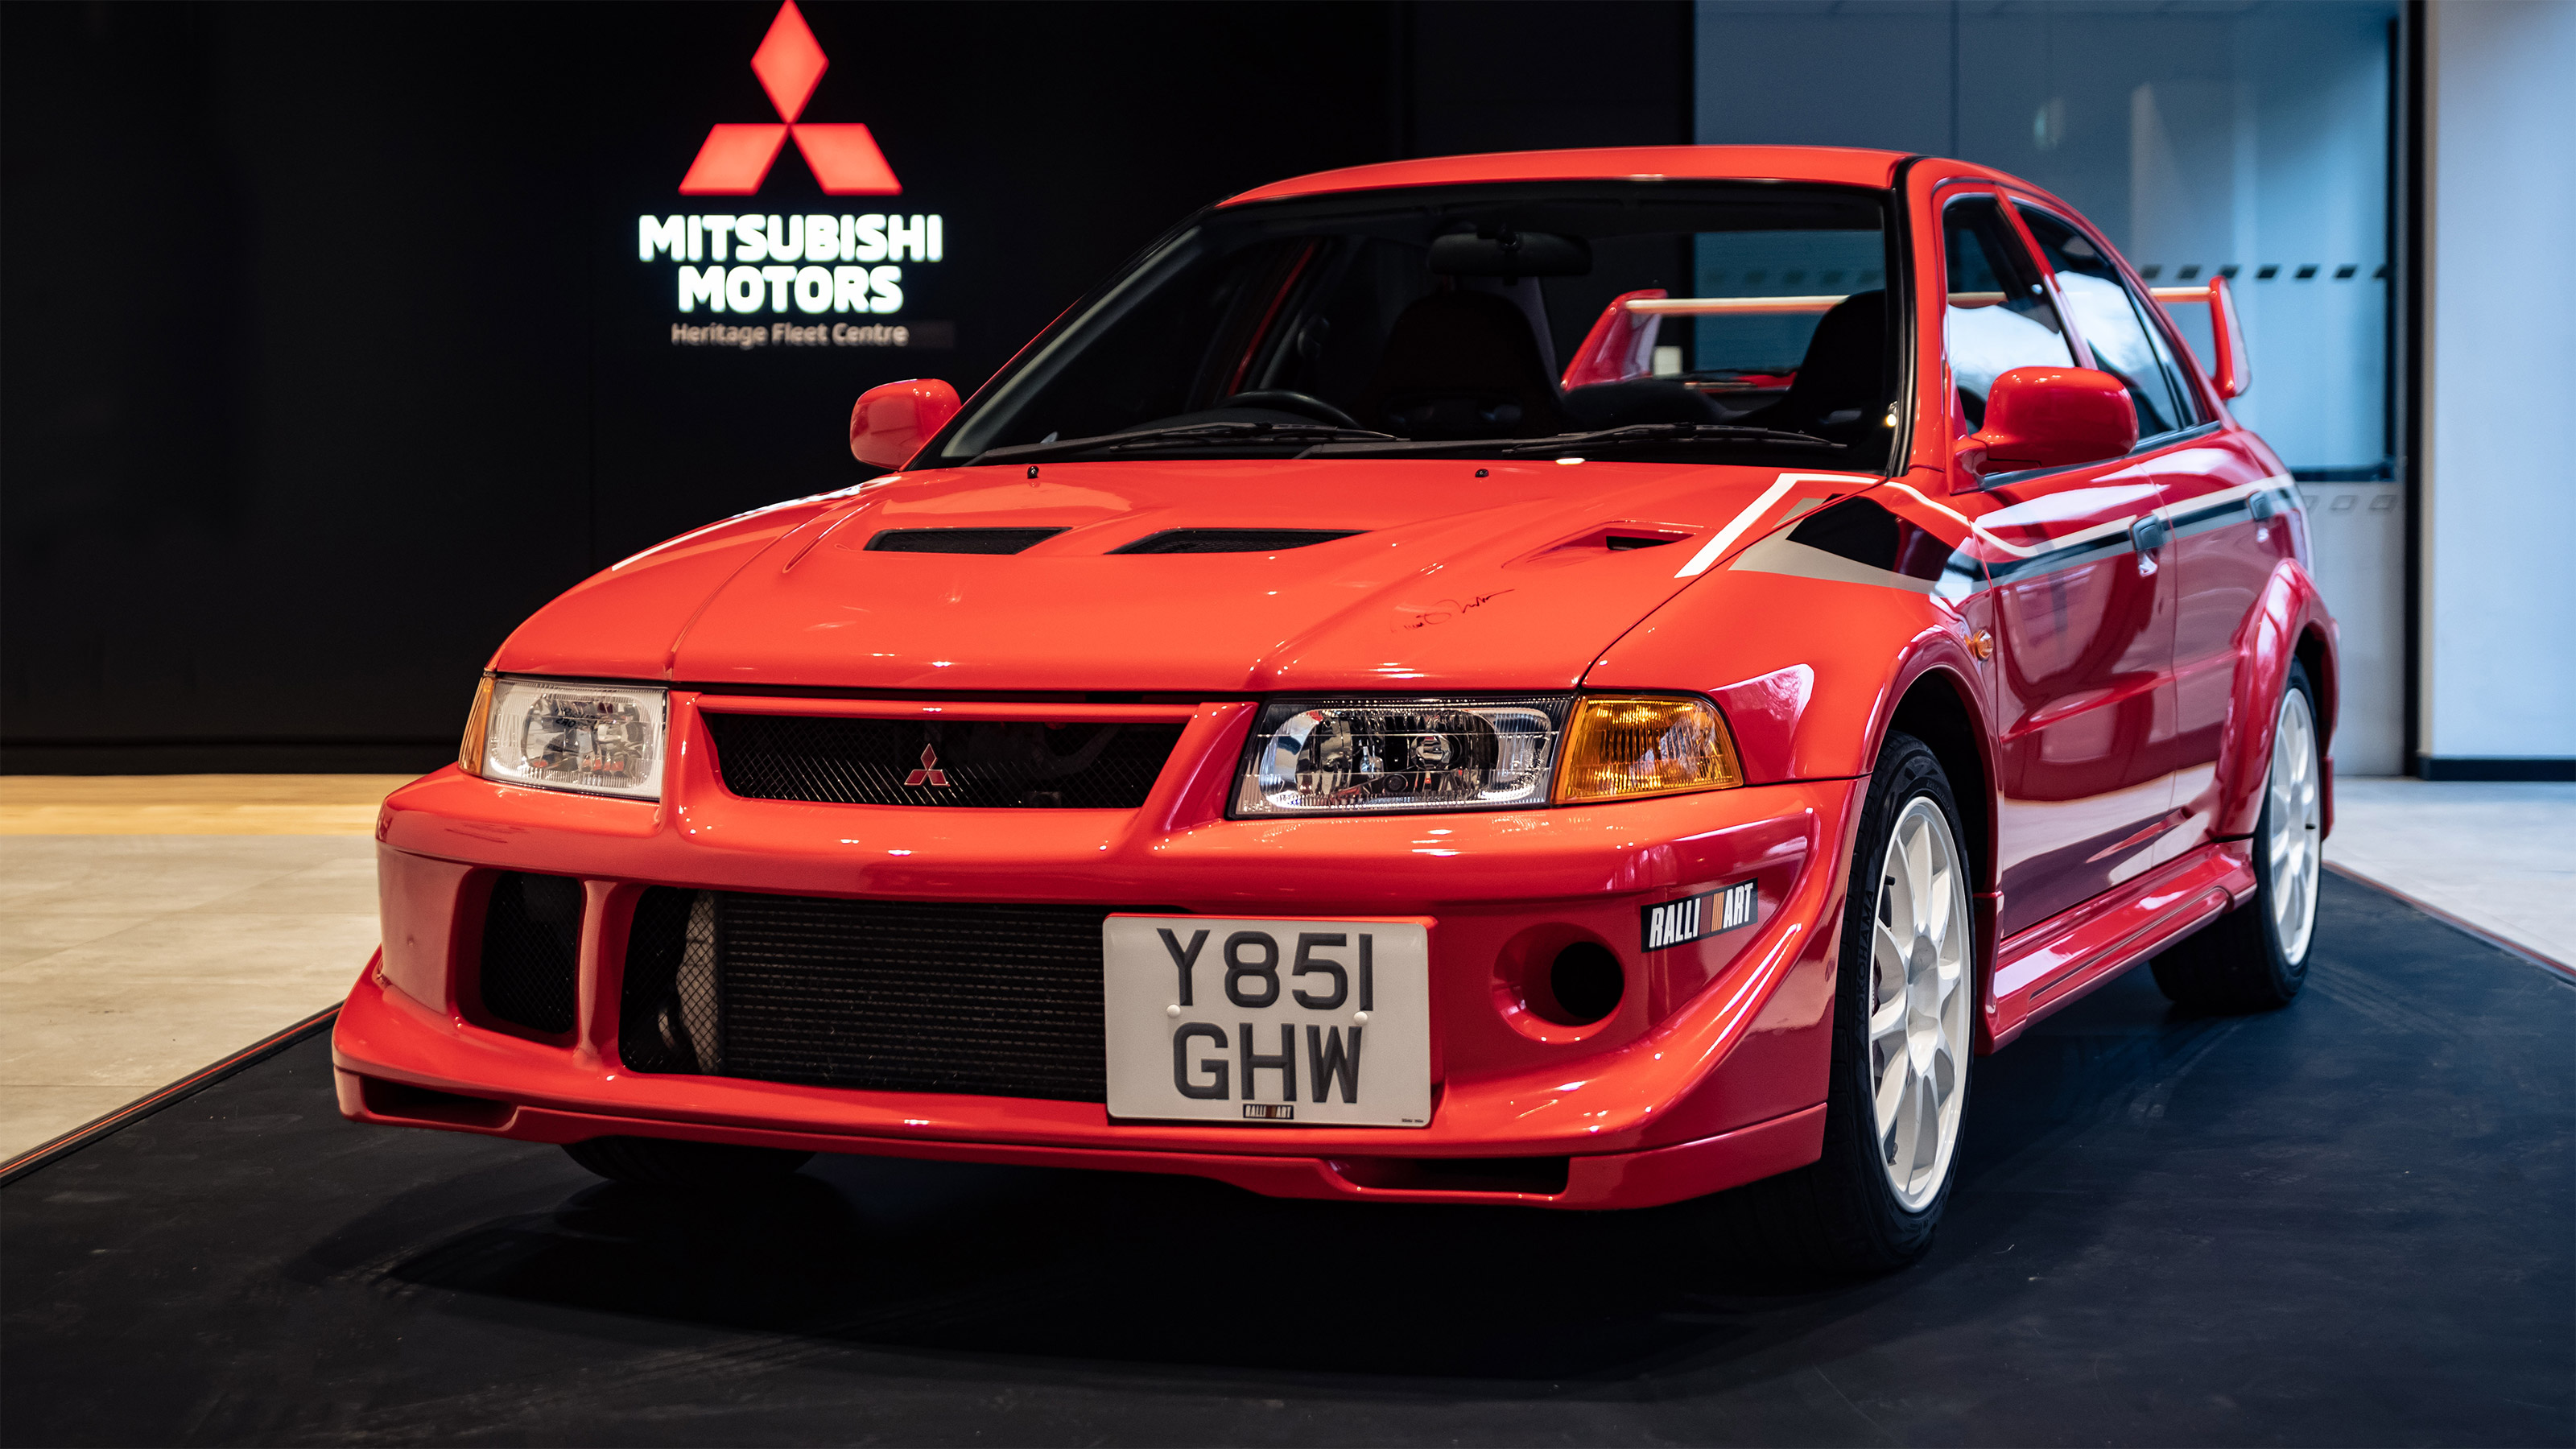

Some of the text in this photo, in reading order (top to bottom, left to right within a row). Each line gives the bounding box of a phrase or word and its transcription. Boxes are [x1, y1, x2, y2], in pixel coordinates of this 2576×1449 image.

[638, 214, 943, 262] MITSUBISHI
[678, 265, 904, 315] MOTORS
[671, 322, 910, 350] Heritage Fleet Centre
[1156, 928, 1373, 1011] Y851
[1856, 890, 1874, 1027] YOKOHAMA
[1172, 1022, 1363, 1104] GHW
